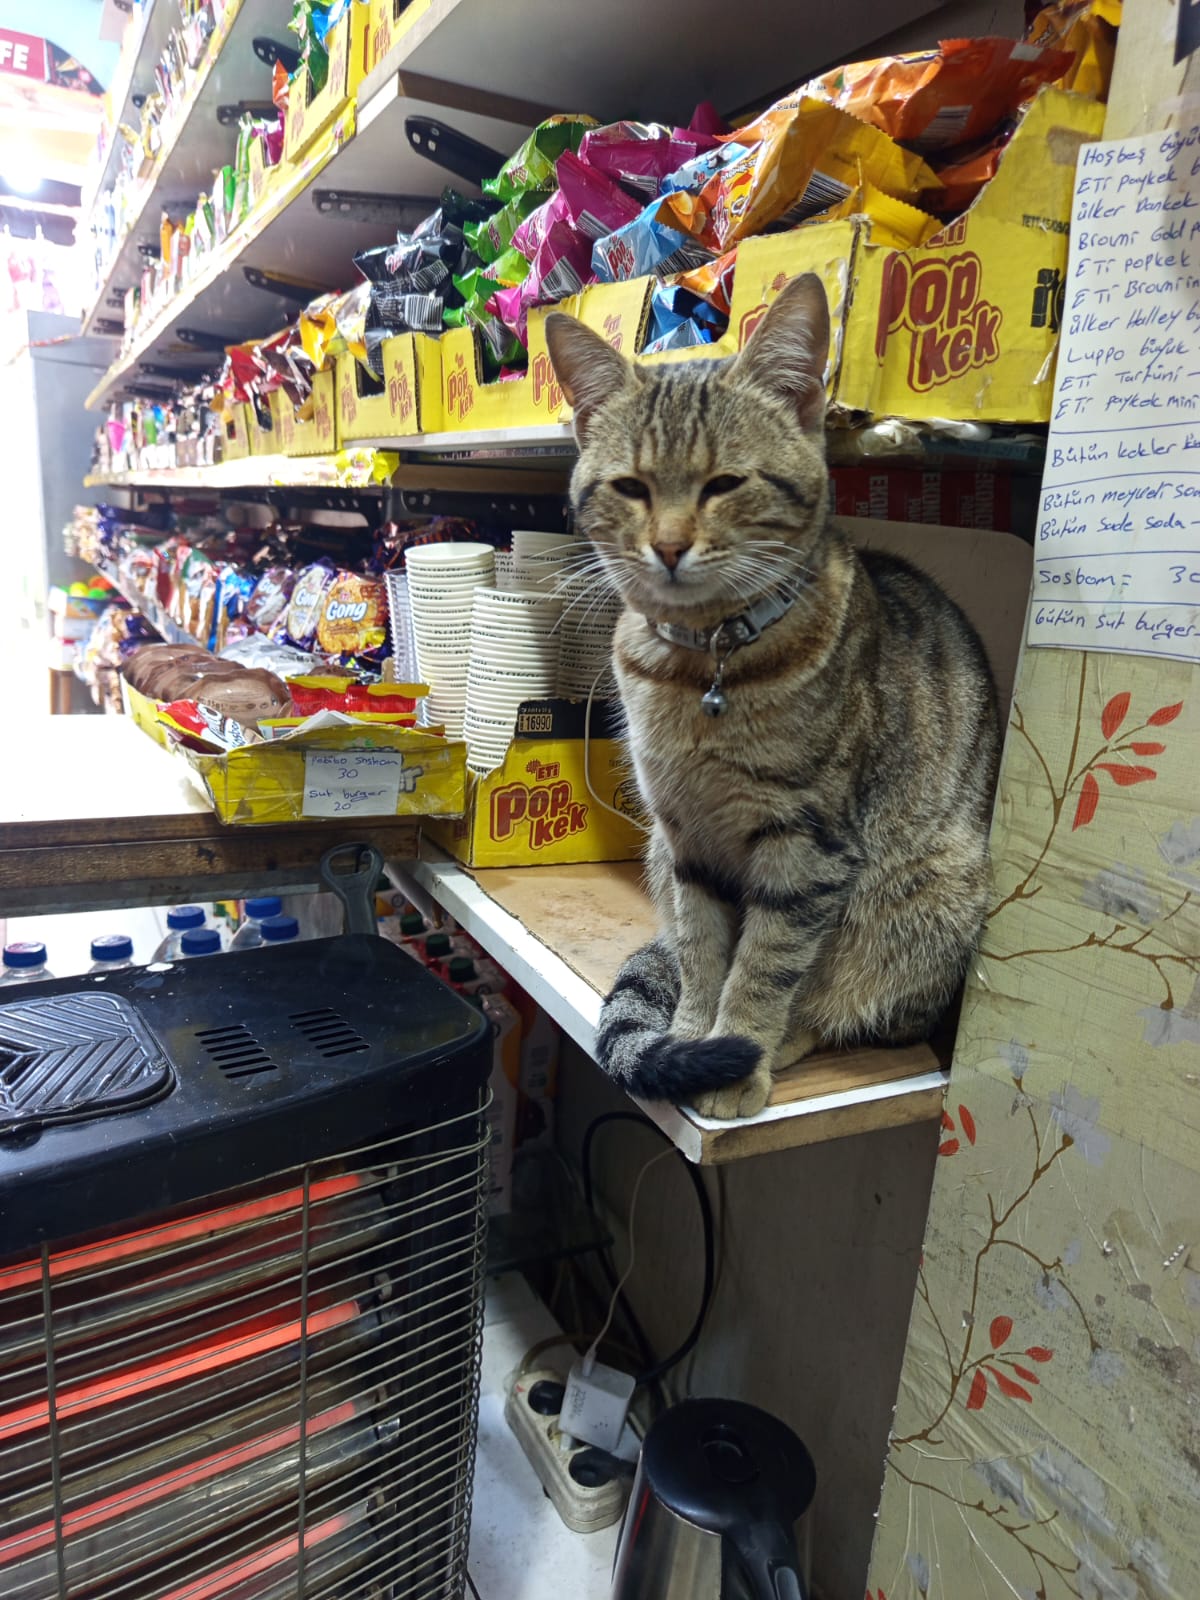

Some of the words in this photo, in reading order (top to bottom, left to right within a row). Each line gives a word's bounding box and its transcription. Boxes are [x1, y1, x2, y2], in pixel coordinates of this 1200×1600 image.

[1160, 126, 1200, 161] büyü
[1067, 347, 1124, 366] Luppo
[869, 475, 888, 520] EKON
[326, 600, 367, 621] Gong
[338, 768, 358, 779] 30
[334, 801, 351, 811] 20
